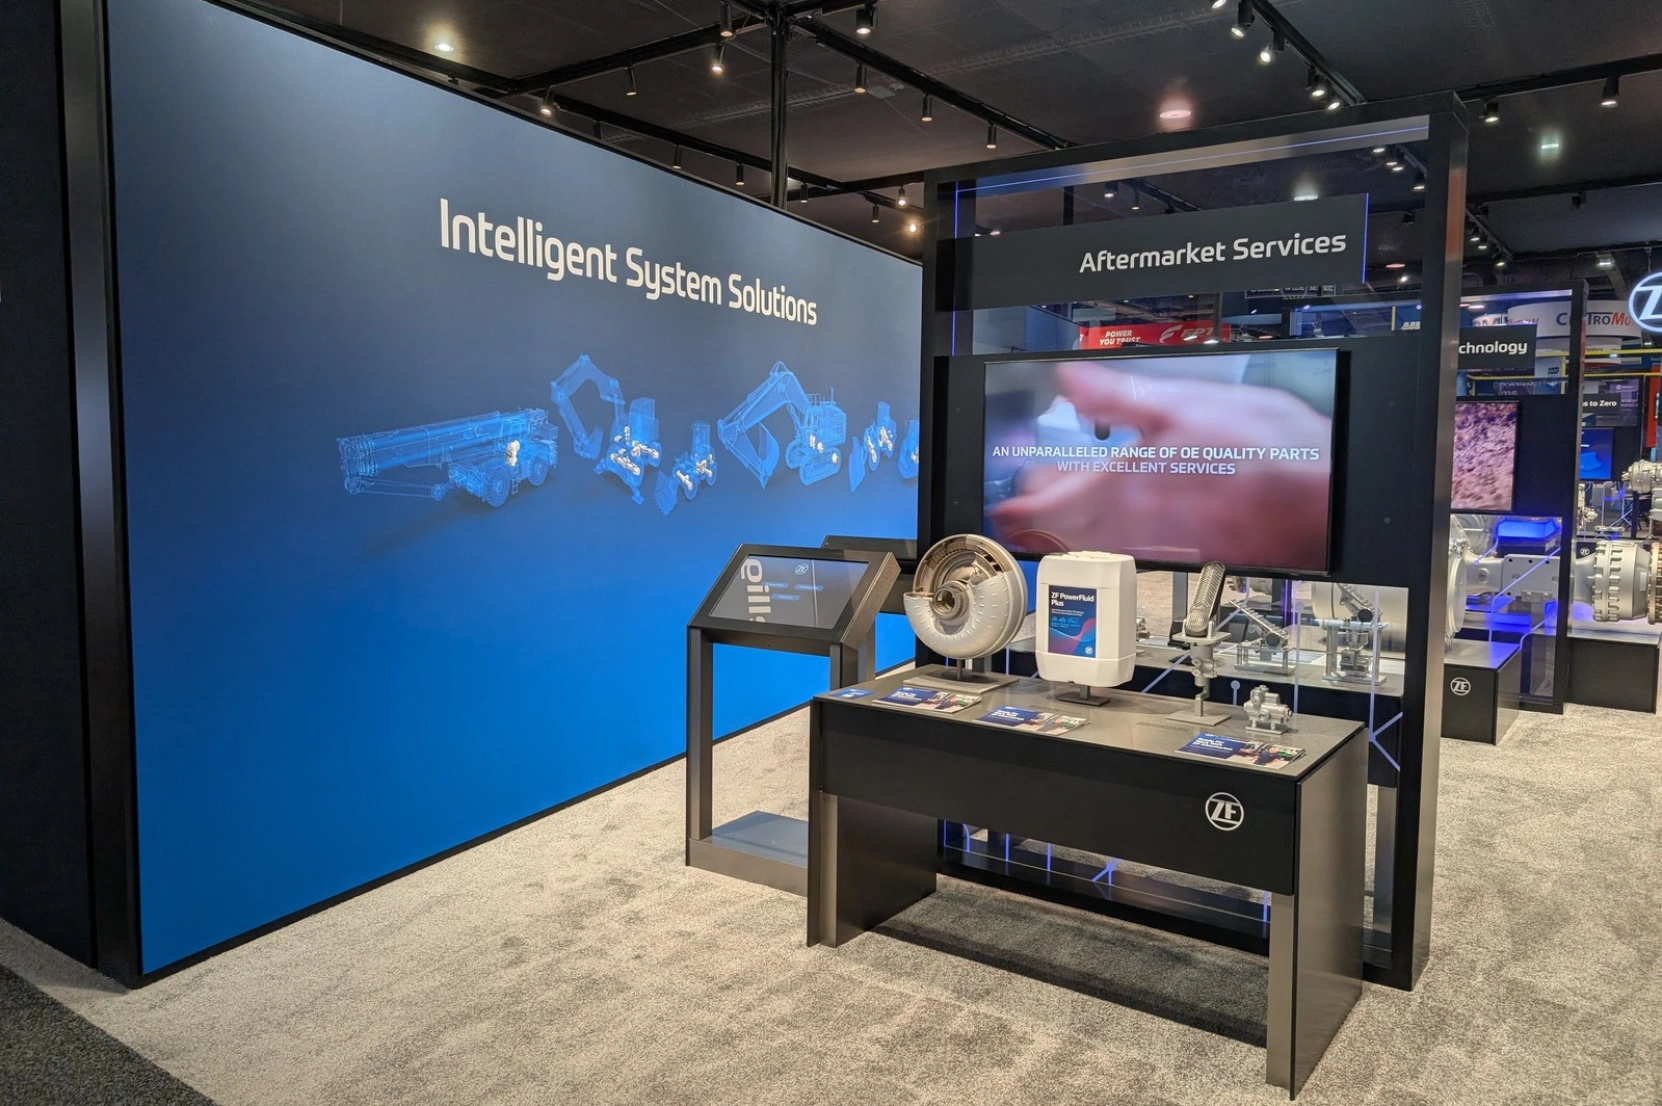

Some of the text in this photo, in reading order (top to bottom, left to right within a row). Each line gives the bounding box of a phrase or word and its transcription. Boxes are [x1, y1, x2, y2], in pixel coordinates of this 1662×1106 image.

[1079, 232, 1347, 273] Aftermarket Services
[440, 198, 817, 326] Intelligent System Solutions
[1105, 329, 1133, 338] POWER
[1100, 338, 1115, 346] YOU
[1458, 340, 1527, 355] chnology
[992, 446, 1320, 461] AN UNPARALLELED RANGE OF OE QUALITY PARTS
[1056, 460, 1236, 475] WITH EXCELLENT SERVICES
[1051, 591, 1095, 602] ZF PowerFluid
[1051, 599, 1065, 607] Plus
[1451, 678, 1471, 694] ZF
[1207, 795, 1242, 828] ZF
